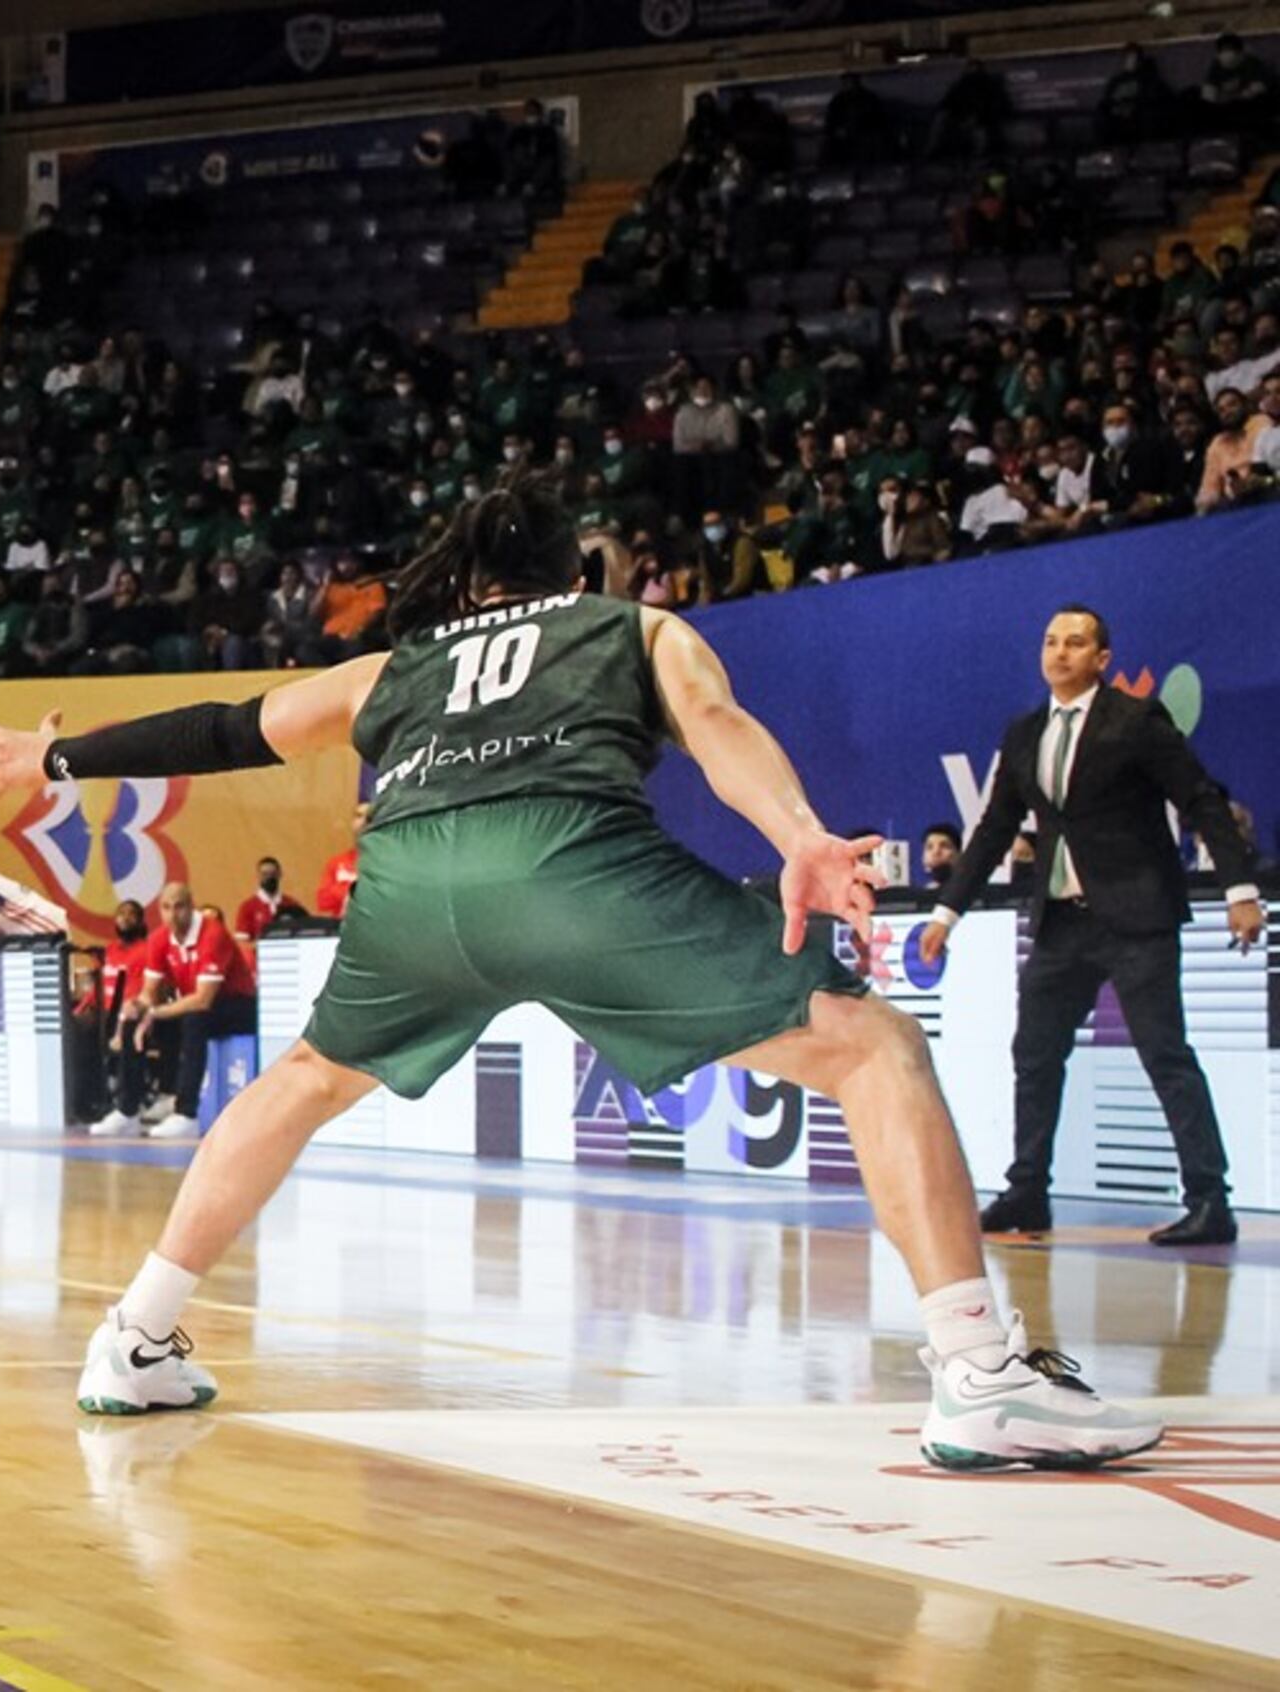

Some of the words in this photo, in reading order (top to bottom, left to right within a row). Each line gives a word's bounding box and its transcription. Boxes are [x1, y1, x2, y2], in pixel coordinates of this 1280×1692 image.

[443, 622, 541, 715] 10
[435, 727, 572, 767] CAPITL
[681, 1490, 993, 1549] REAL
